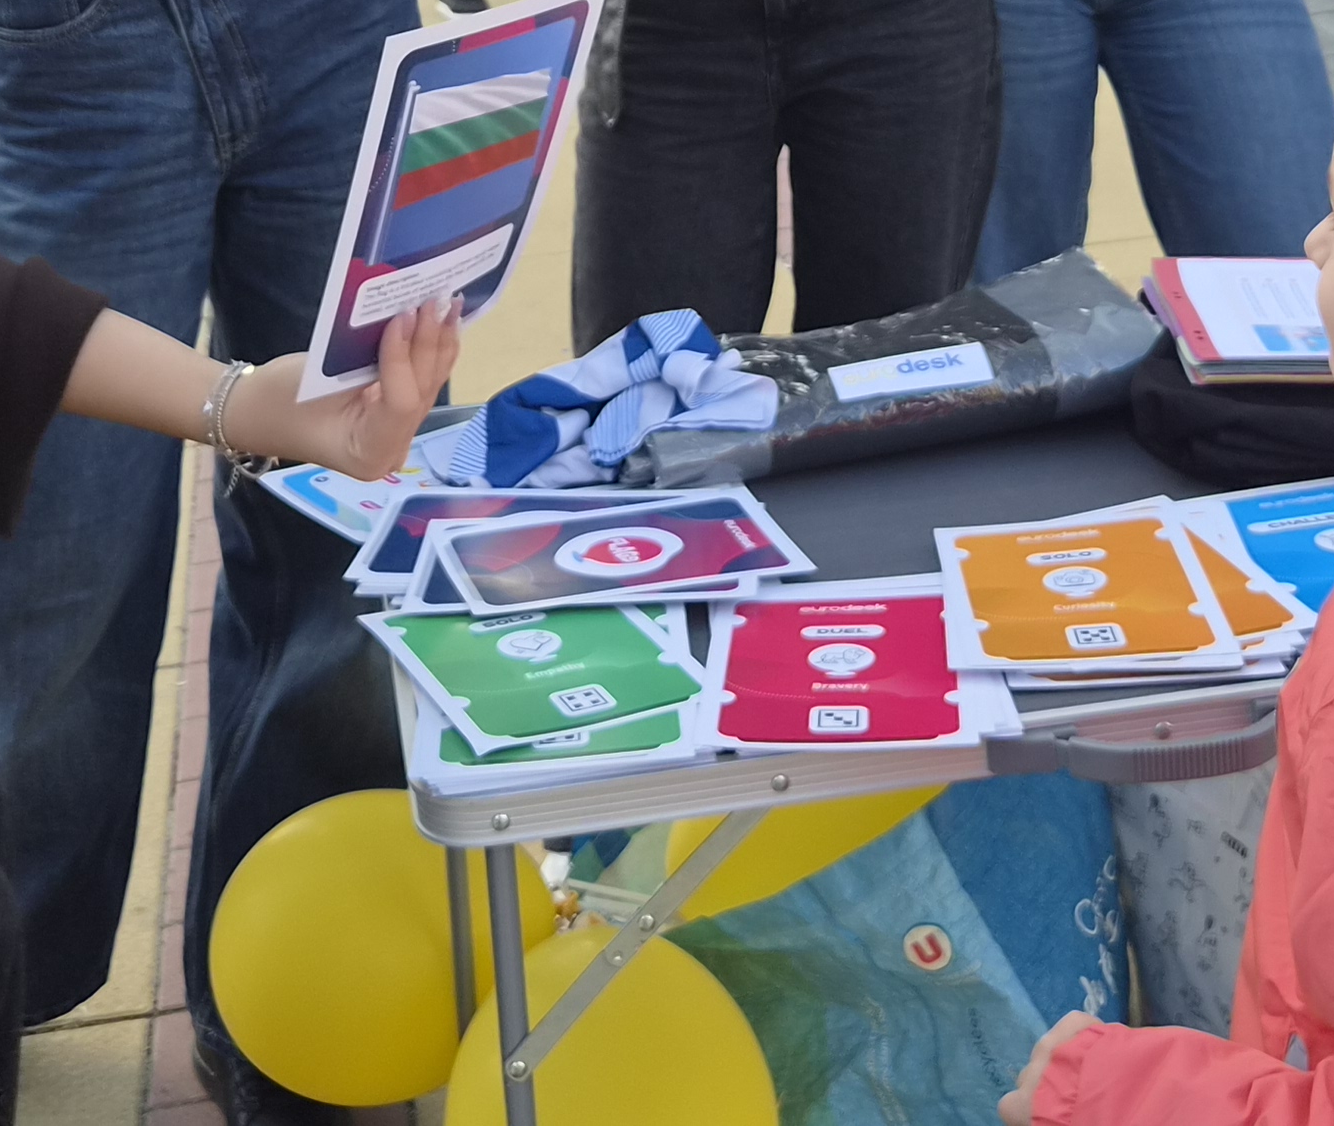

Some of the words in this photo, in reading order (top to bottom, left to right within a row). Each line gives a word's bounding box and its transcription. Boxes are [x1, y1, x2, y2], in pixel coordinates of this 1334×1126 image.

[1040, 550, 1092, 561] SOLO
[798, 603, 888, 615] eurodesk
[482, 613, 534, 628] SOLO
[910, 932, 943, 964] U
